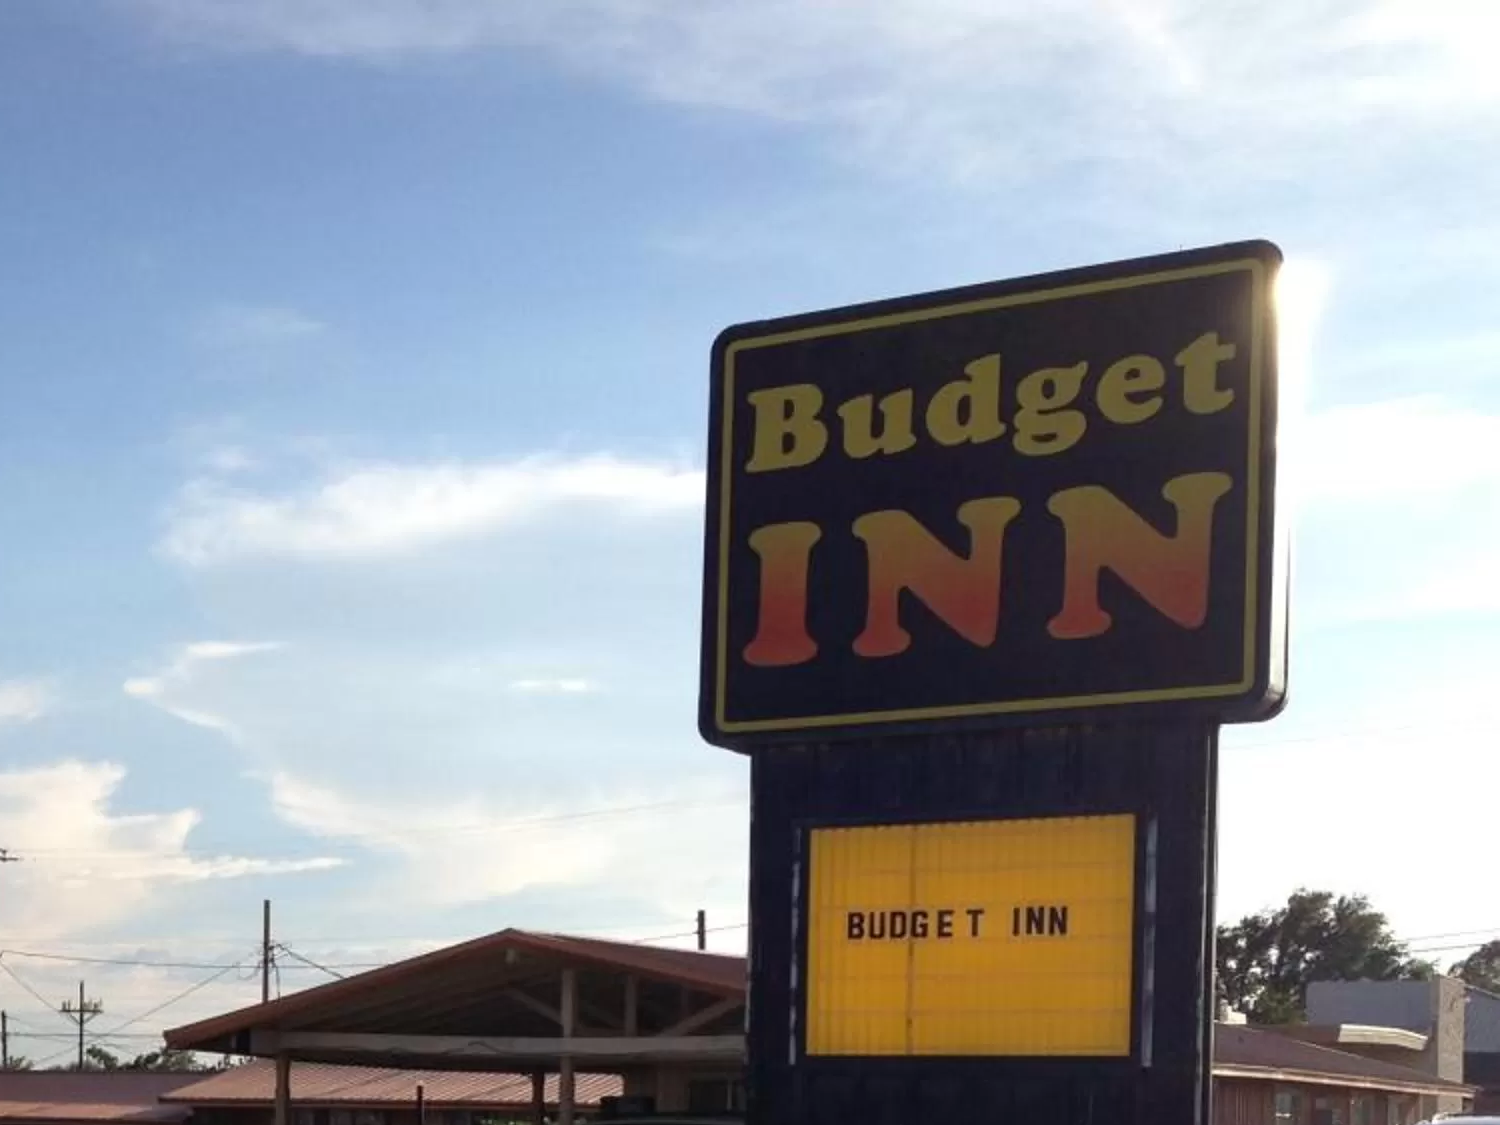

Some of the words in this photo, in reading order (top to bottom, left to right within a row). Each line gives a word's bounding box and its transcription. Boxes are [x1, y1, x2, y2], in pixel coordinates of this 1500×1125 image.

[745, 331, 1236, 473] Budget
[743, 472, 1233, 667] INN
[848, 909, 984, 939] BUDGET
[1012, 907, 1068, 936] INN
